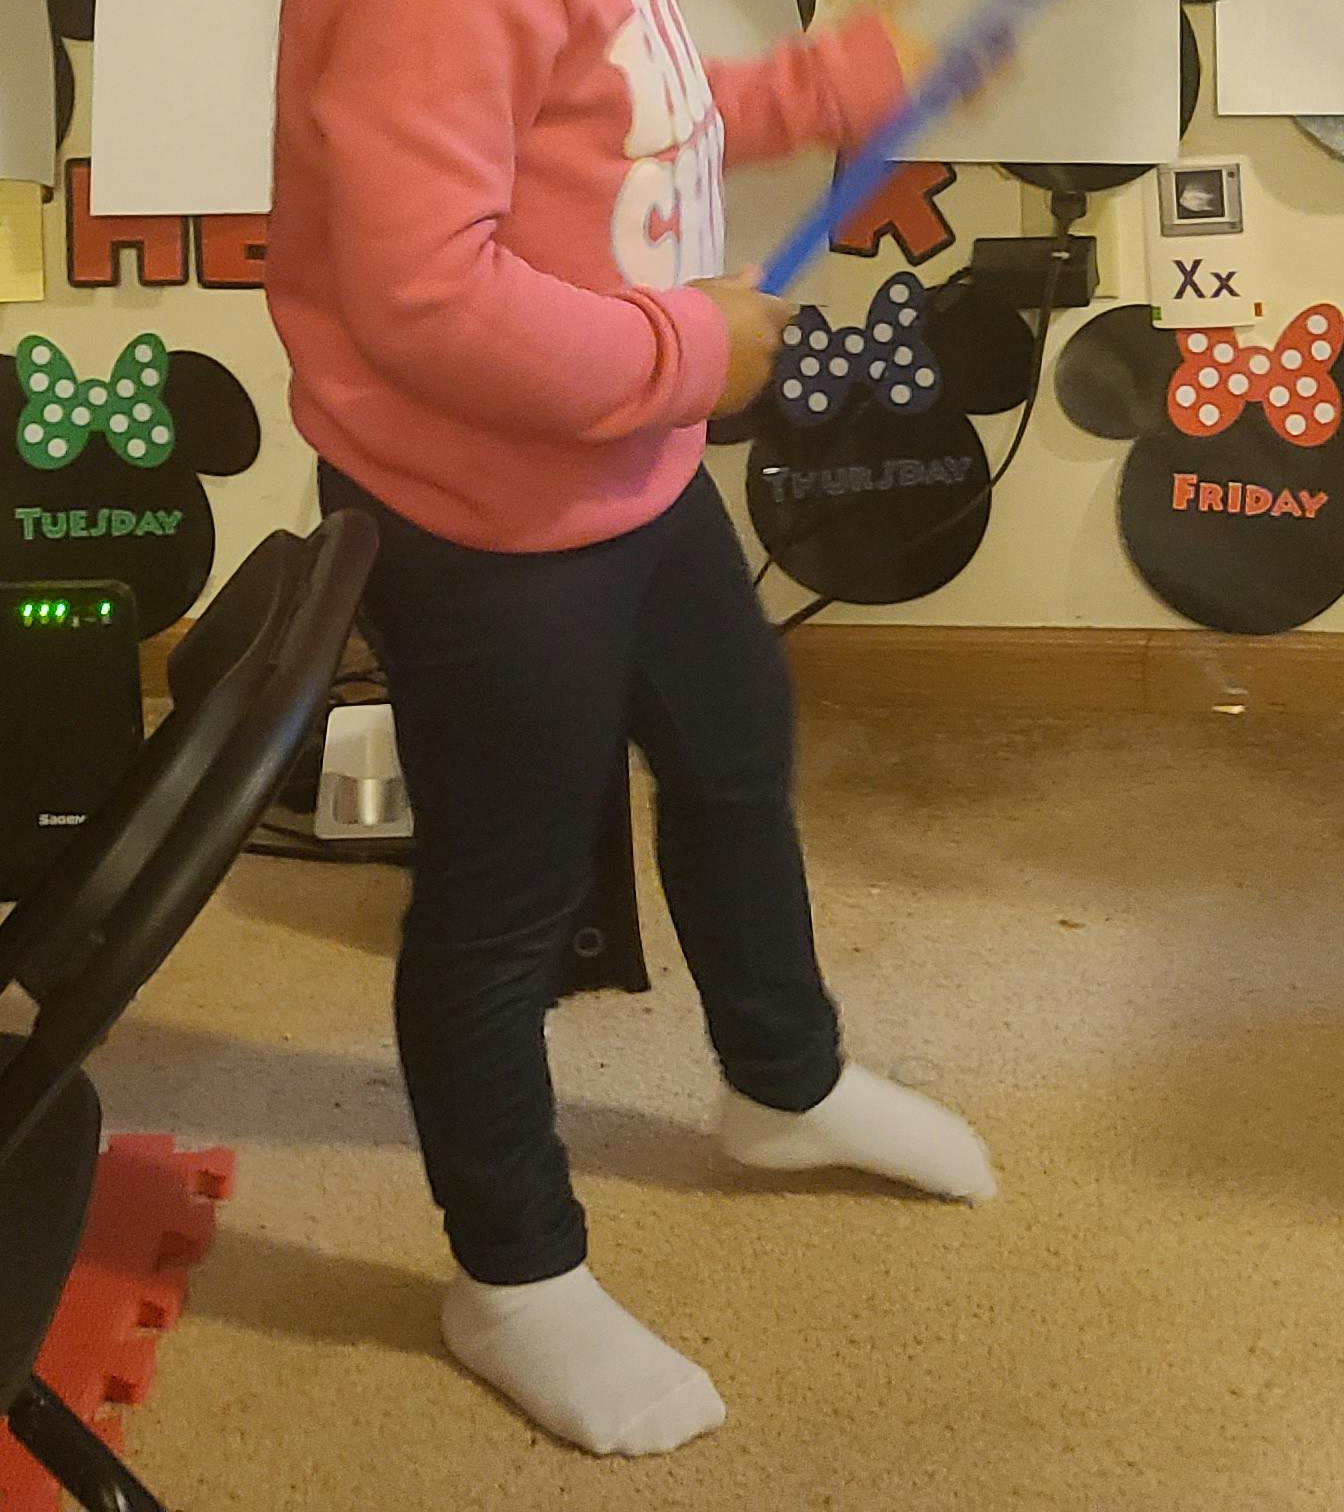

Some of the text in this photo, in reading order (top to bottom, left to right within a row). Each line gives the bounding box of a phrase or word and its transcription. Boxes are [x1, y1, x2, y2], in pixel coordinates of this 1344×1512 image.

[1174, 259, 1240, 299] Xx
[762, 456, 973, 503] THURSDAY
[1171, 472, 1328, 519] FRIDAY
[15, 506, 183, 539] TUESDAY
